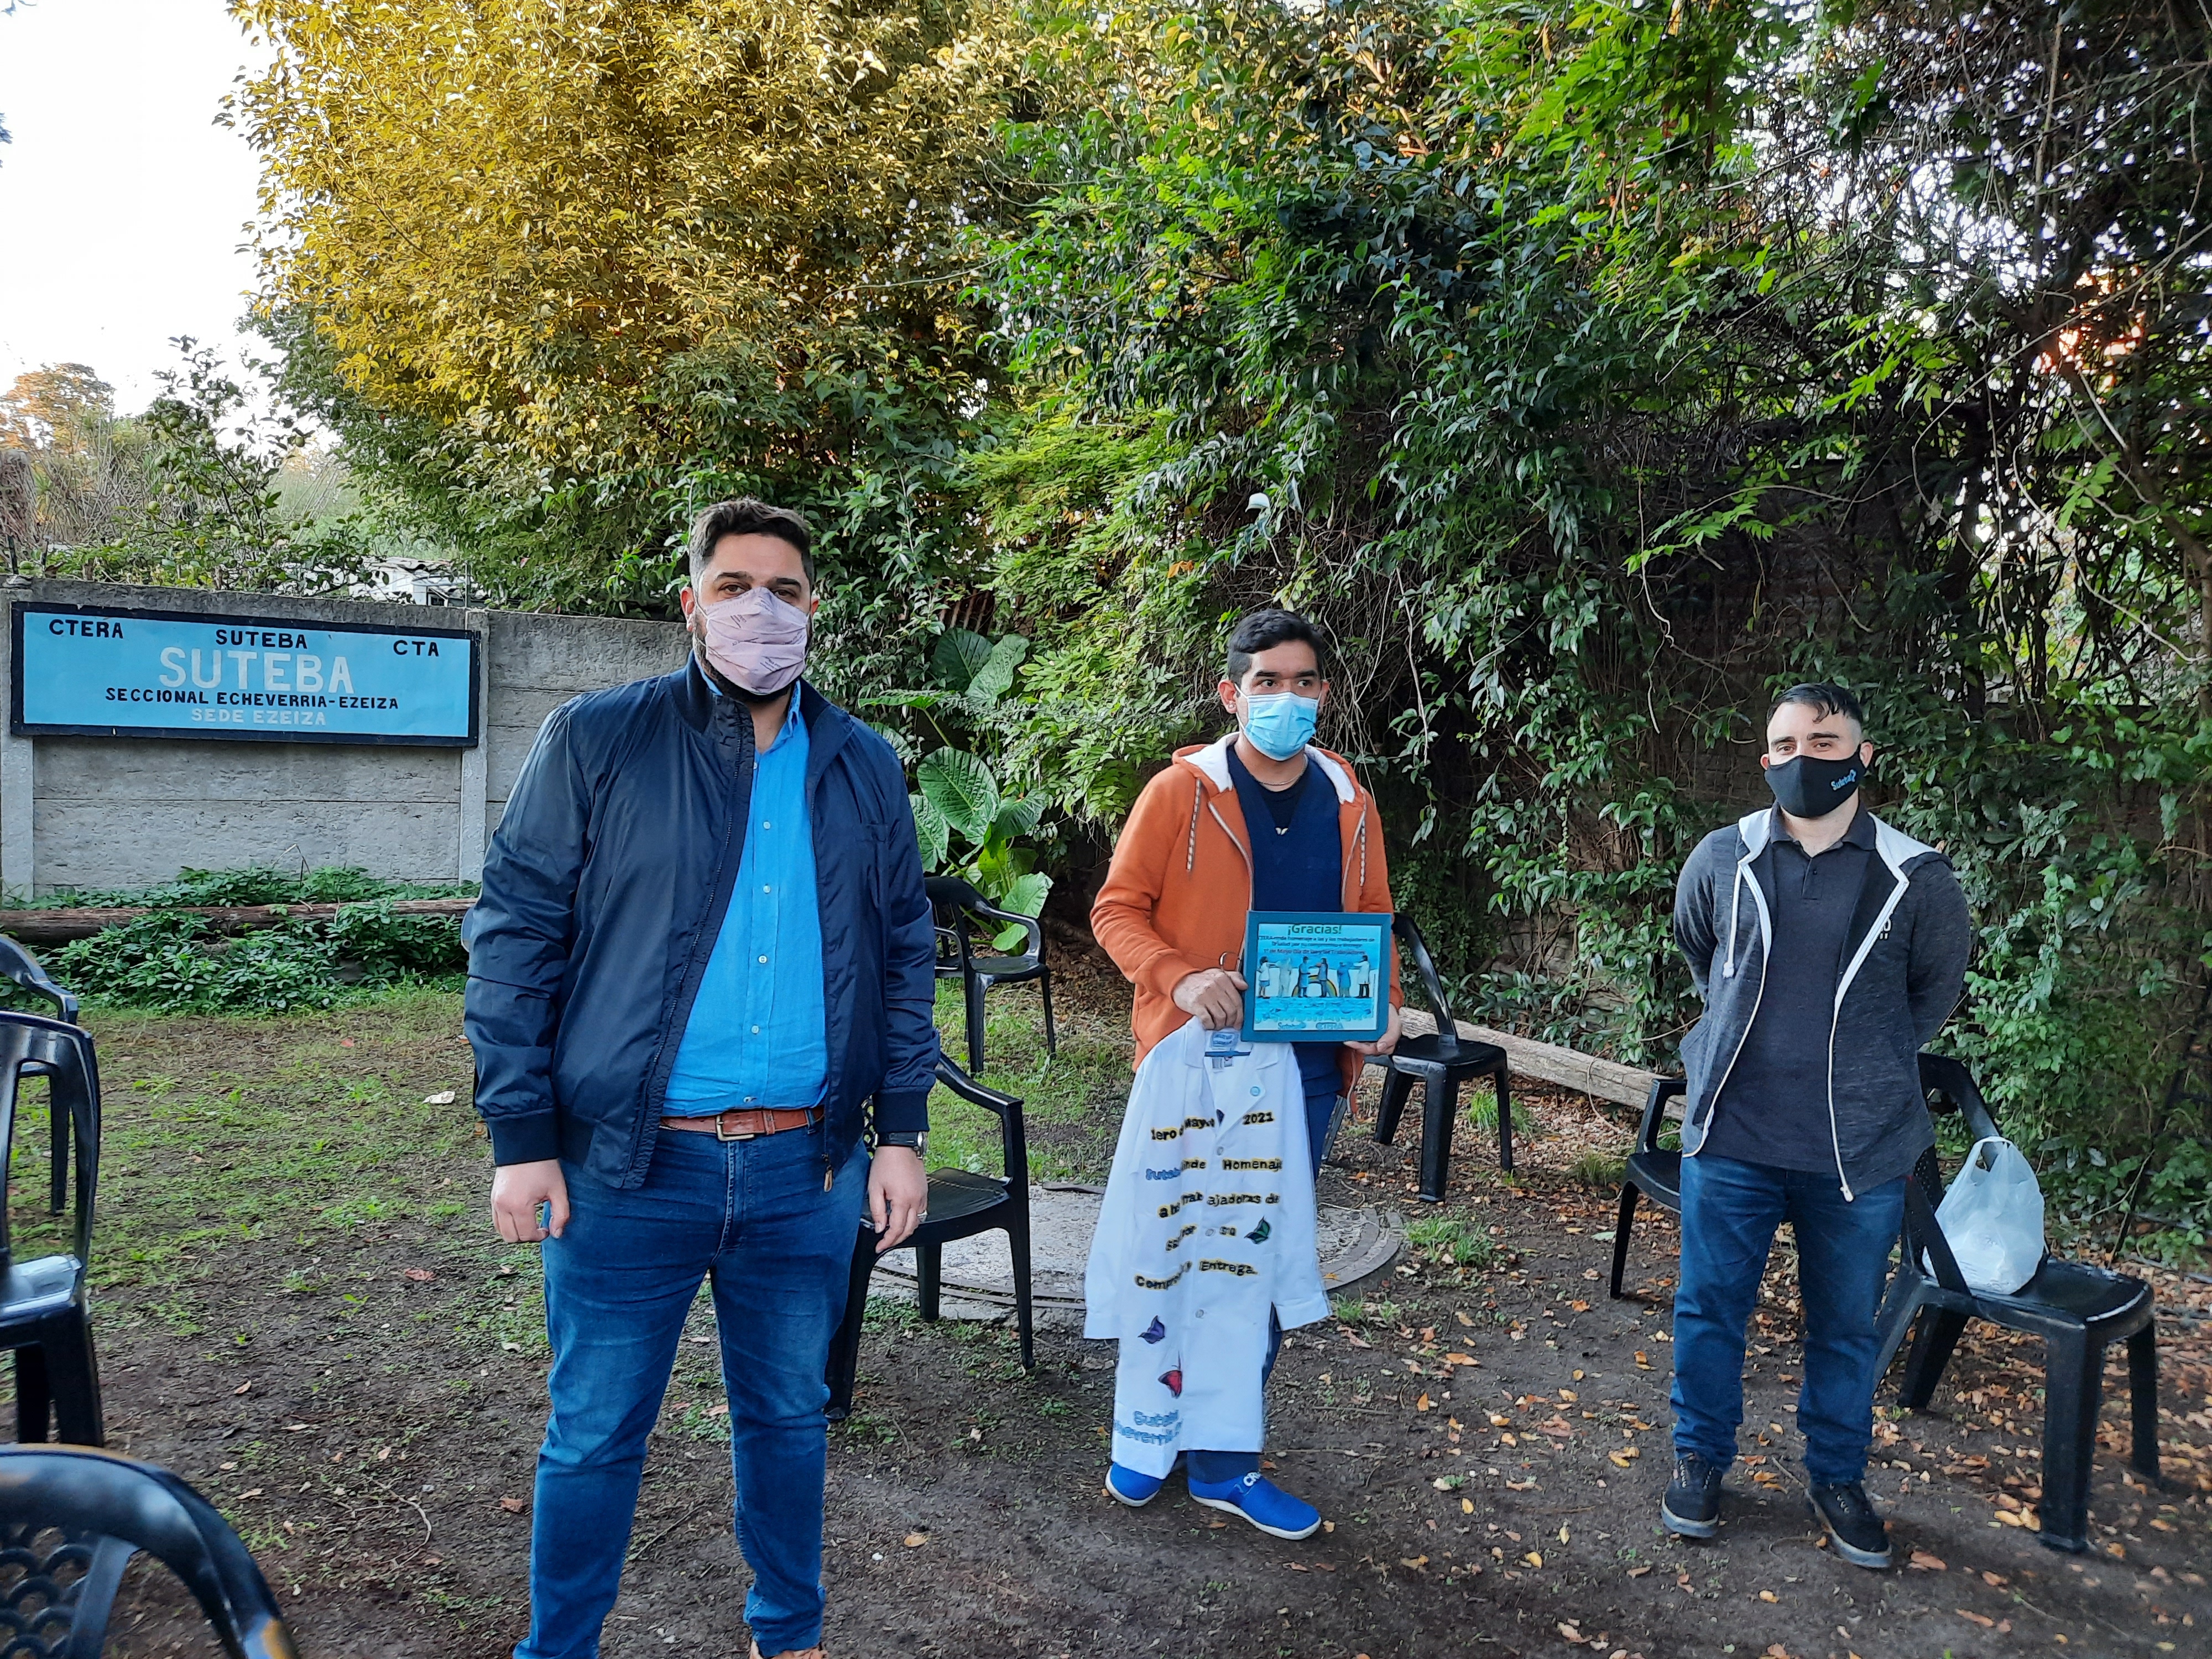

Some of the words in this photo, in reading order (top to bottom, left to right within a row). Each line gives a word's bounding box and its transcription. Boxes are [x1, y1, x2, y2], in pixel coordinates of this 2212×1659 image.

[49, 619, 123, 639] CTERA
[216, 629, 307, 650] SUTEBA
[393, 640, 439, 657] CTA
[159, 646, 354, 694] SUTEBA
[106, 687, 208, 704] SECCIONAL
[191, 708, 244, 723] SEDE
[253, 710, 326, 726] EZEIZA
[1243, 1112, 1274, 1125] 2021
